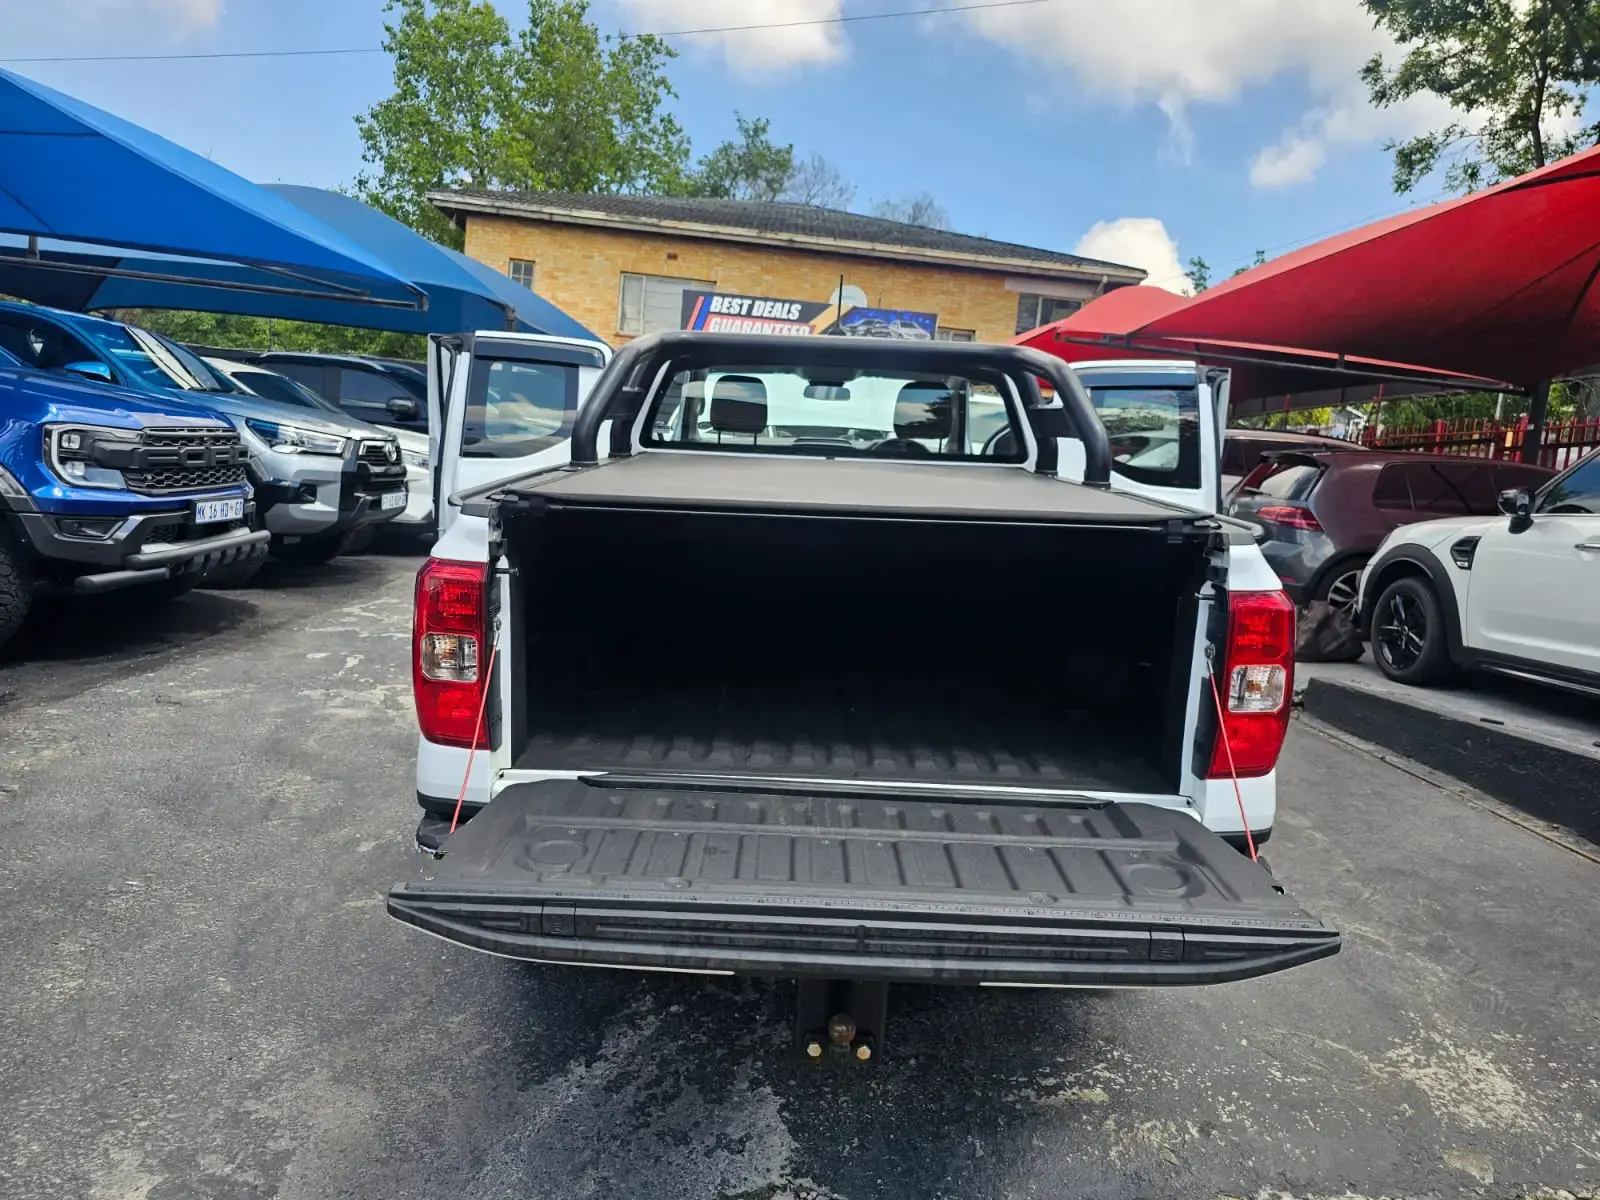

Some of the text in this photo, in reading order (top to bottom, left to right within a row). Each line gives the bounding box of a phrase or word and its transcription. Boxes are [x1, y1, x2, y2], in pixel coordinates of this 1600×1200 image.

[709, 296, 801, 320] BEST DEALS
[209, 503, 217, 519] 16
